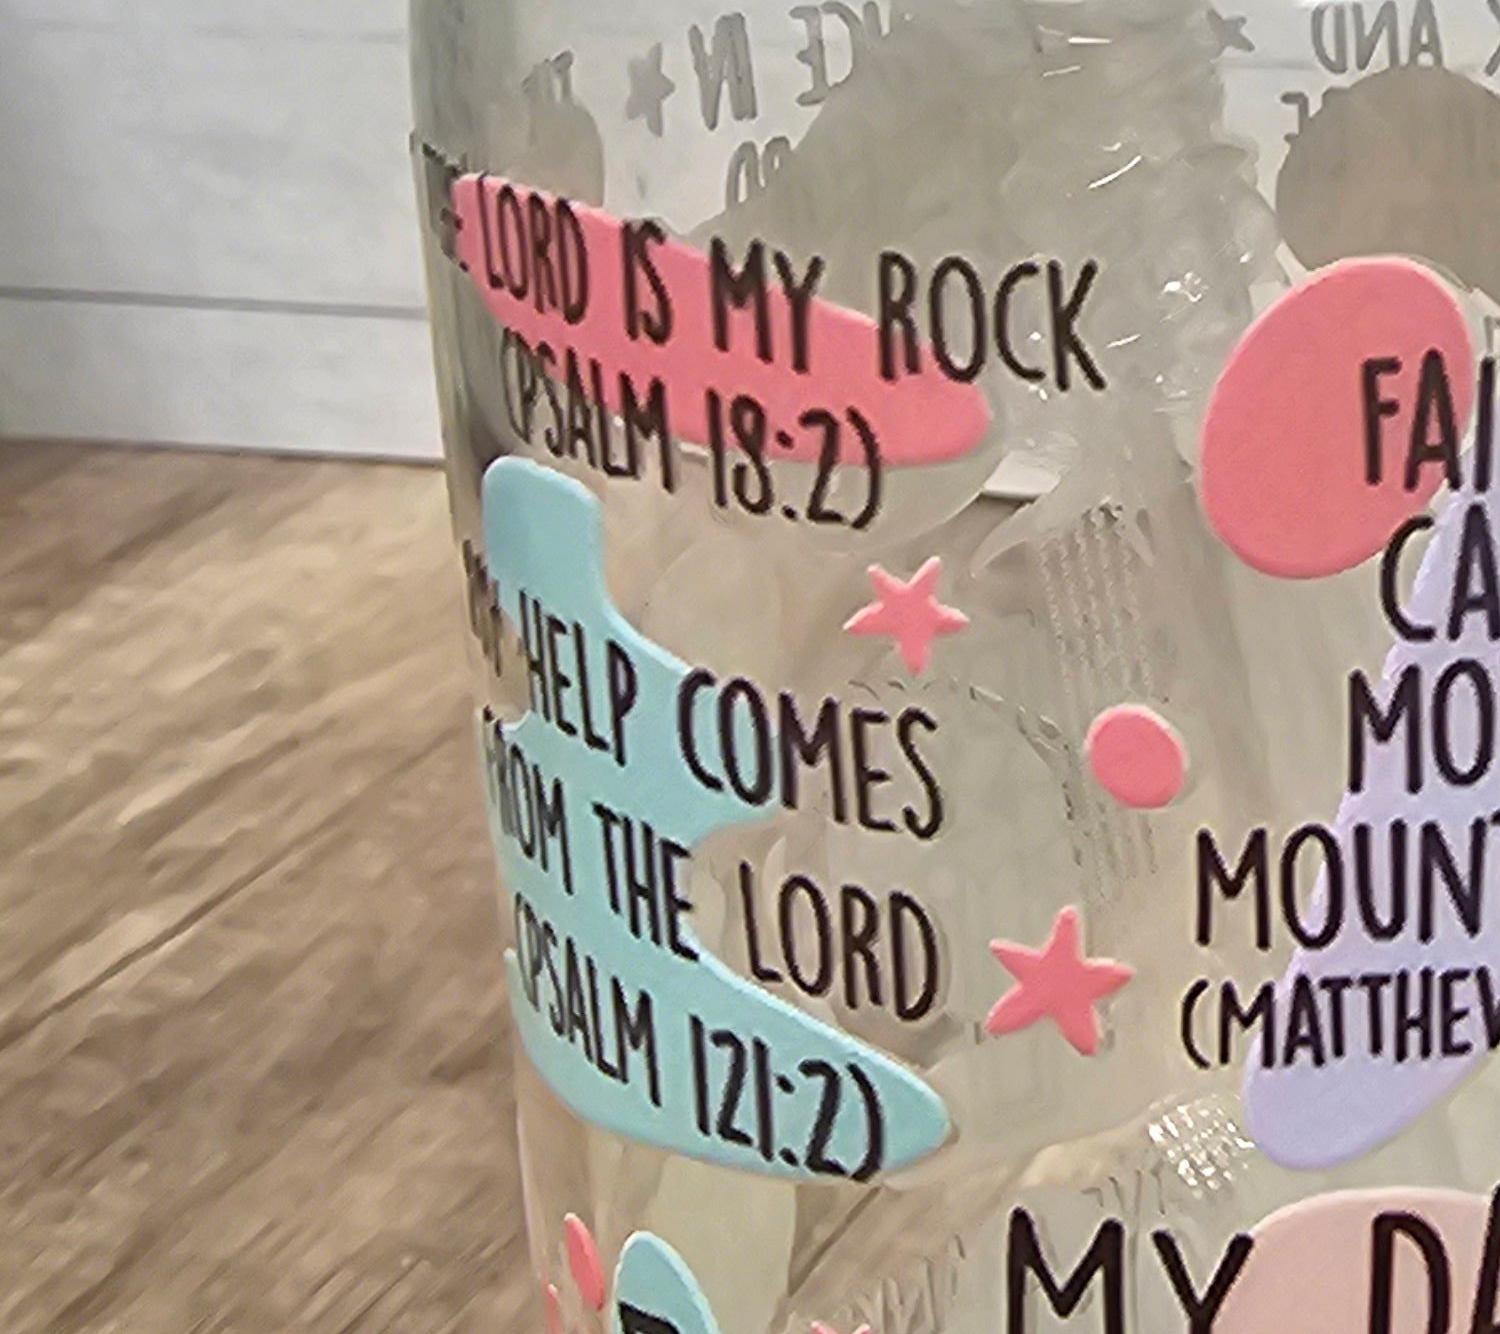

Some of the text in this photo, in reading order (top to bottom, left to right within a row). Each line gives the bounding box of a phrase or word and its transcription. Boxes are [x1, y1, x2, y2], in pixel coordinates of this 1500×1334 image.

[476, 171, 588, 325] LORD
[619, 217, 672, 345] IS
[709, 236, 825, 373] MY
[877, 250, 1108, 392] ROCK
[500, 328, 883, 531] (PSALM 18:2)
[518, 589, 638, 767] HELP
[677, 667, 946, 841] COMES
[591, 800, 700, 962] THE
[739, 861, 940, 1022] LORD
[512, 892, 886, 1183] (PSALM 121:2)
